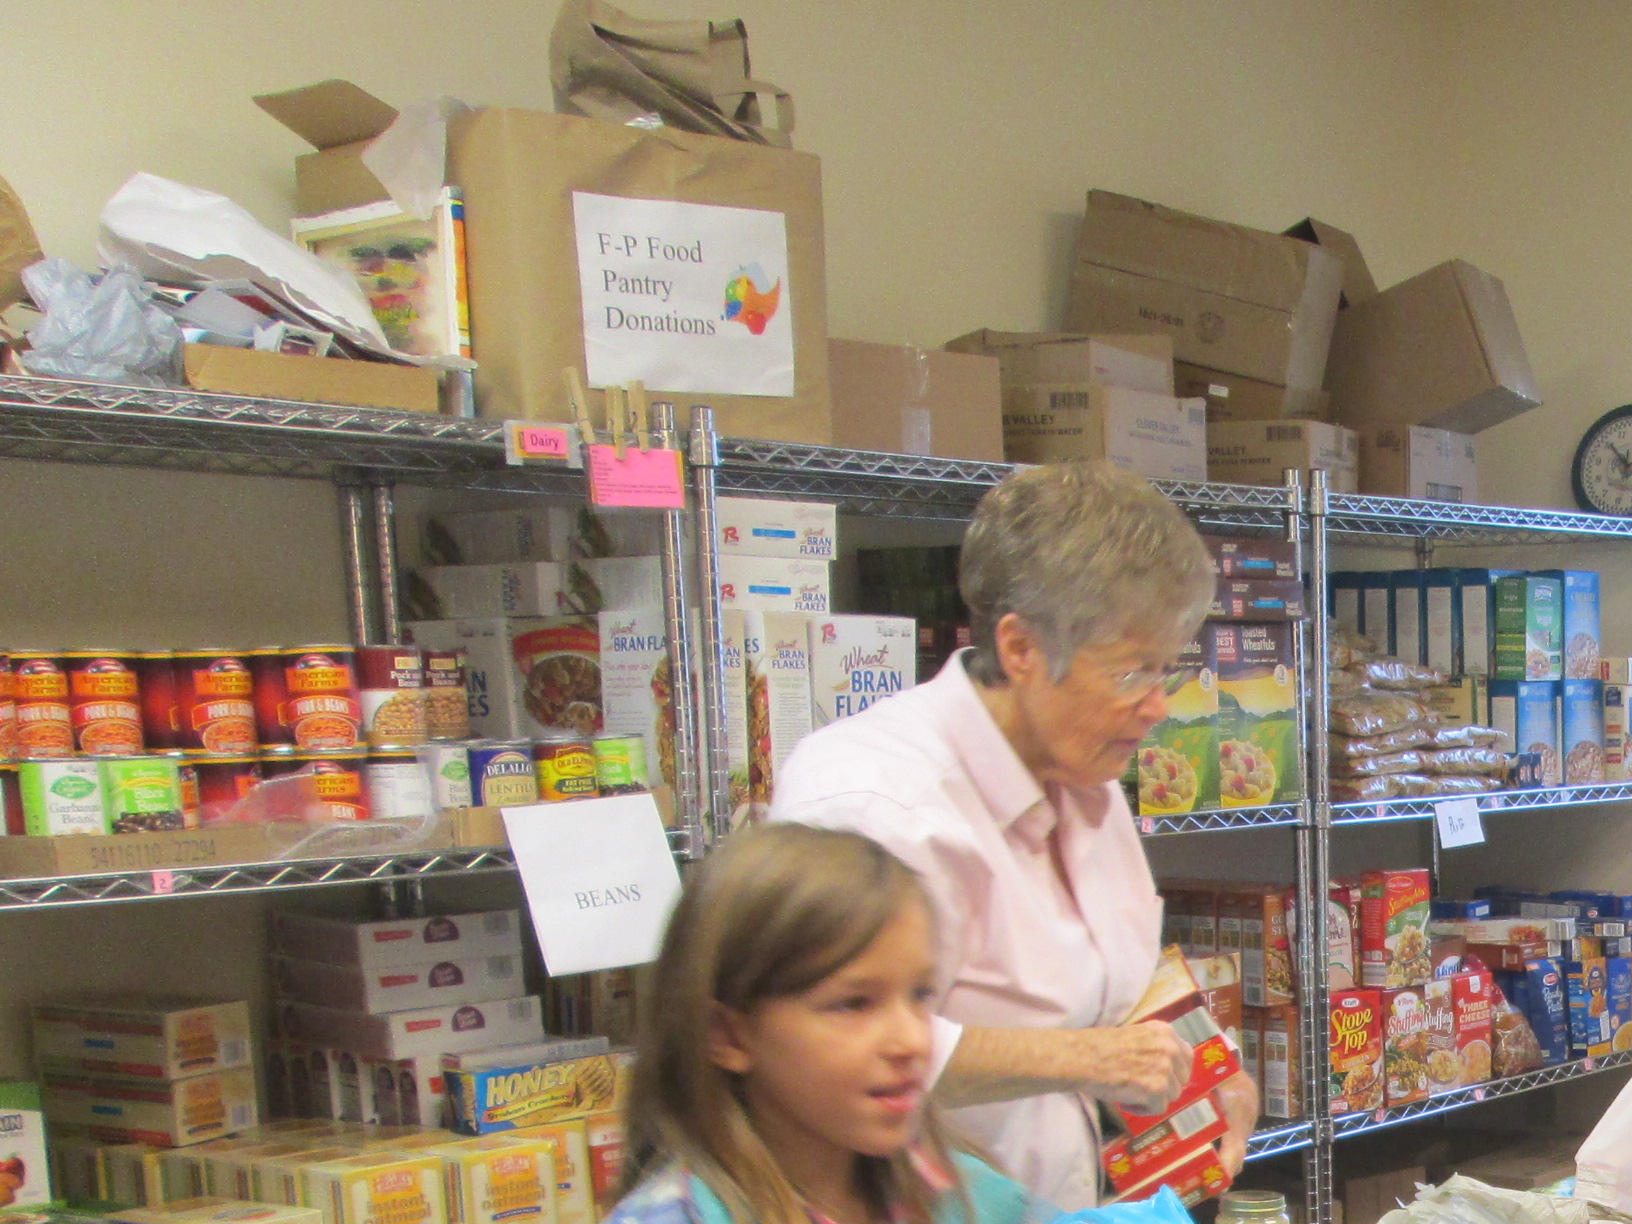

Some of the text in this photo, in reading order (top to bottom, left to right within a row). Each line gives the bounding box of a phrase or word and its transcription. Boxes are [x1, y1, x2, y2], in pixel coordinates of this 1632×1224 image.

[597, 233, 703, 263] F-P Food
[603, 269, 673, 302] Pantry
[605, 305, 716, 335] Donations
[1013, 414, 1056, 425] VALLEY
[530, 434, 560, 450] Dairy
[807, 537, 831, 546] BRAN
[800, 545, 831, 555] FLAKES
[802, 593, 826, 602] BRAN
[795, 602, 826, 611] FLAKES
[614, 636, 645, 651] BRAN
[779, 649, 805, 659] BRAN
[840, 644, 894, 674] Wheat
[772, 659, 806, 669] FLAKES
[293, 669, 346, 679] American
[300, 679, 338, 688] Farms
[851, 671, 901, 693] BRAN
[486, 763, 533, 777] DELALLO
[575, 883, 641, 910] BEANS
[1463, 1000, 1488, 1013] THREE
[1459, 1010, 1490, 1023] CHEESE
[1330, 1008, 1373, 1046] Stove
[1343, 1030, 1368, 1054] Top
[486, 1063, 575, 1107] HONEY
[486, 1176, 541, 1197] instant
[366, 1193, 426, 1214] instant
[482, 1185, 546, 1211] oatmeal
